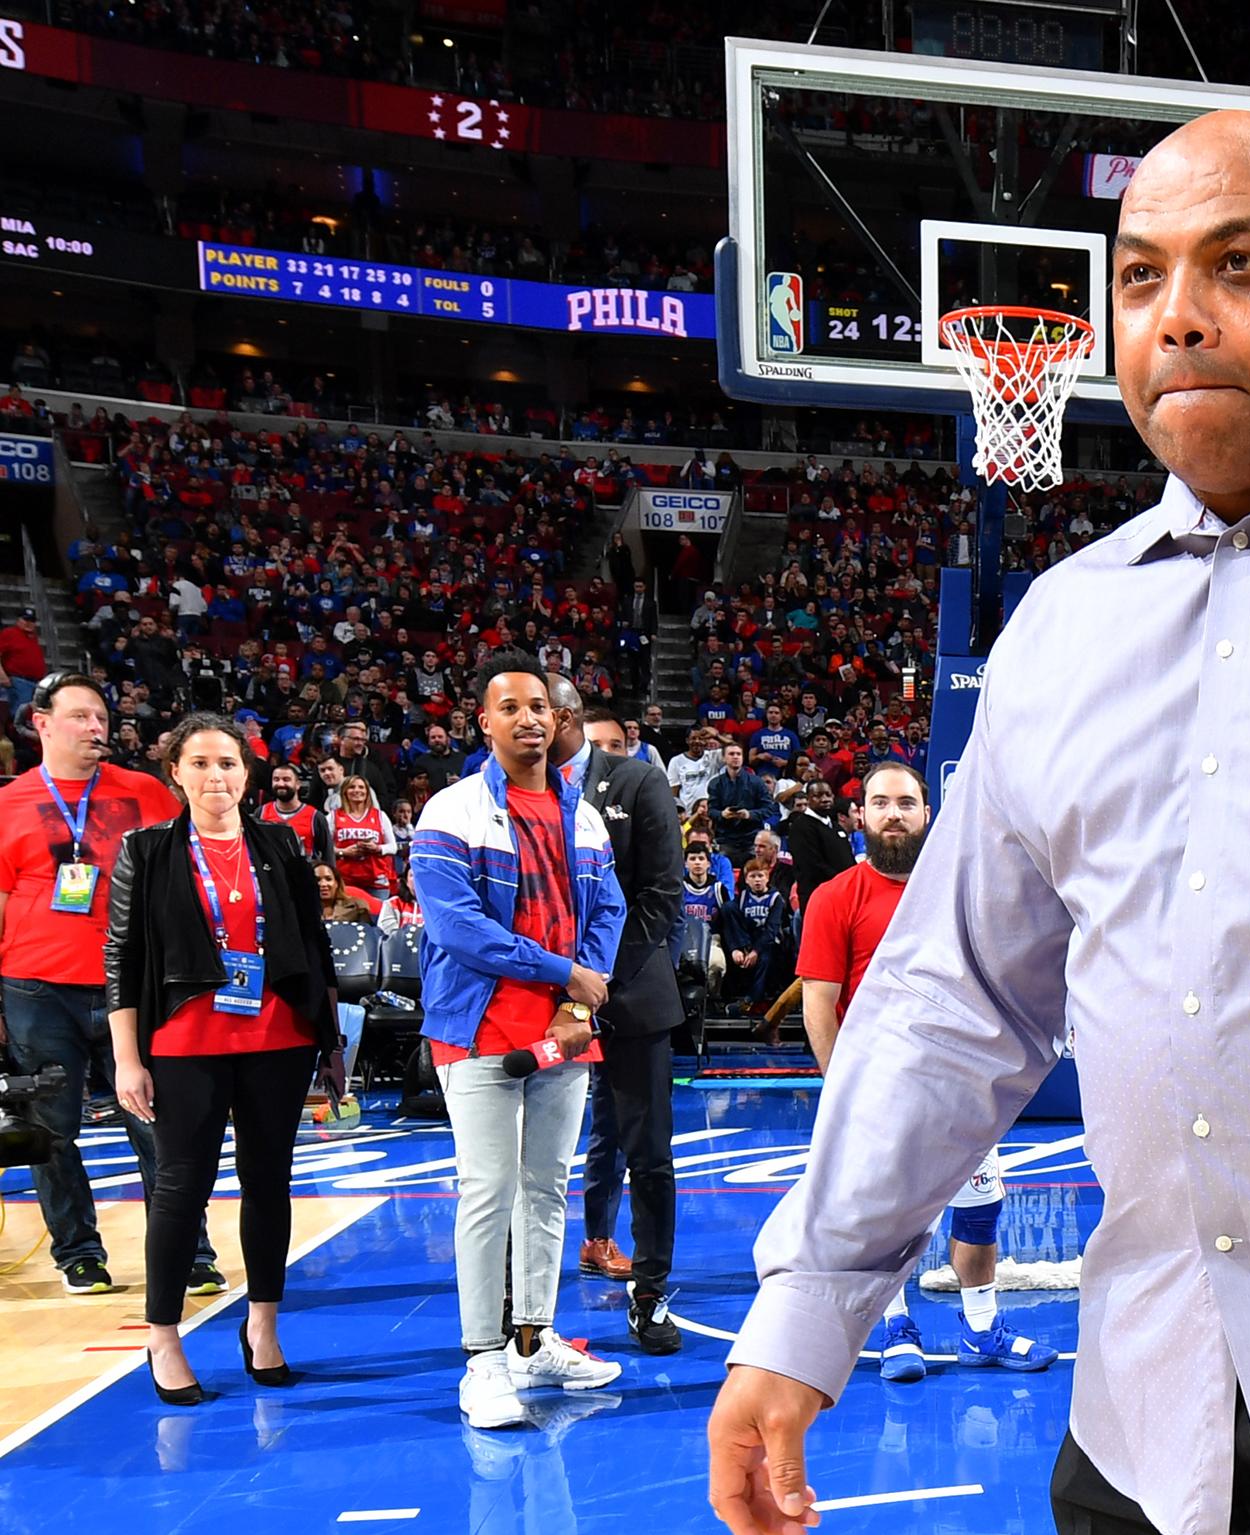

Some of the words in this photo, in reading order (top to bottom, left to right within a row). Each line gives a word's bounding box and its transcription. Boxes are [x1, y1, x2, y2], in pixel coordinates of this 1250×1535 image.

[456, 101, 483, 140] 2
[1, 217, 36, 236] MIA
[2, 240, 39, 259] SAC
[45, 236, 93, 256] 10:00
[205, 249, 279, 271] PLAYER
[287, 259, 308, 274] 33
[313, 262, 334, 277] 21
[339, 265, 360, 280] 17
[365, 269, 386, 283] 25
[392, 271, 412, 286] 30
[210, 271, 280, 292] POINTS
[292, 281, 303, 295] 7
[318, 285, 332, 298] 4
[340, 287, 361, 301] 18
[371, 291, 382, 304] 8
[397, 294, 410, 307] 4
[424, 276, 470, 292] FOULS
[480, 281, 494, 297] 0
[434, 298, 461, 313] TOL
[482, 302, 494, 318] 5
[567, 288, 688, 338] PHILA
[828, 307, 859, 318] SHOT
[828, 320, 860, 340] 24
[772, 334, 790, 349] NBA
[758, 364, 813, 379] SPALDING
[11, 462, 50, 482] 108
[652, 494, 721, 510] GEICO
[644, 512, 674, 528] 108
[337, 828, 380, 843] SIXERS
